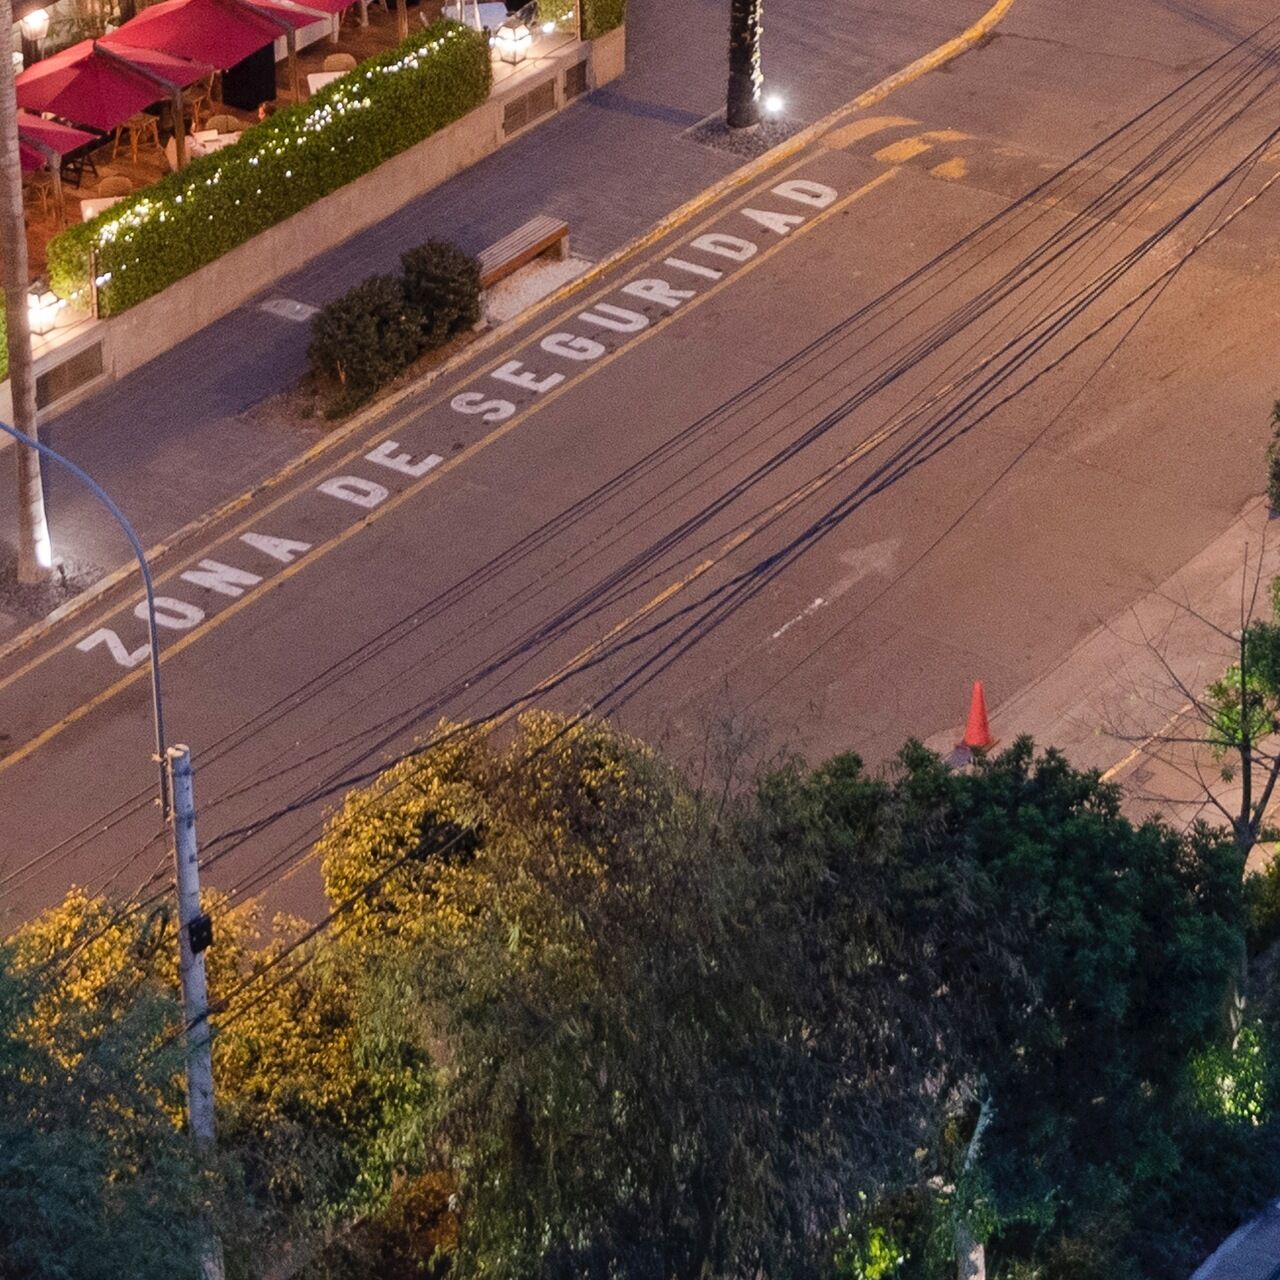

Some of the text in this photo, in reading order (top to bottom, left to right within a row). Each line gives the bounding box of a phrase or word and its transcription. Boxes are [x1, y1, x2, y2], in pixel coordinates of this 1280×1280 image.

[76, 179, 838, 667] ZONA DE SEGURIDAD
